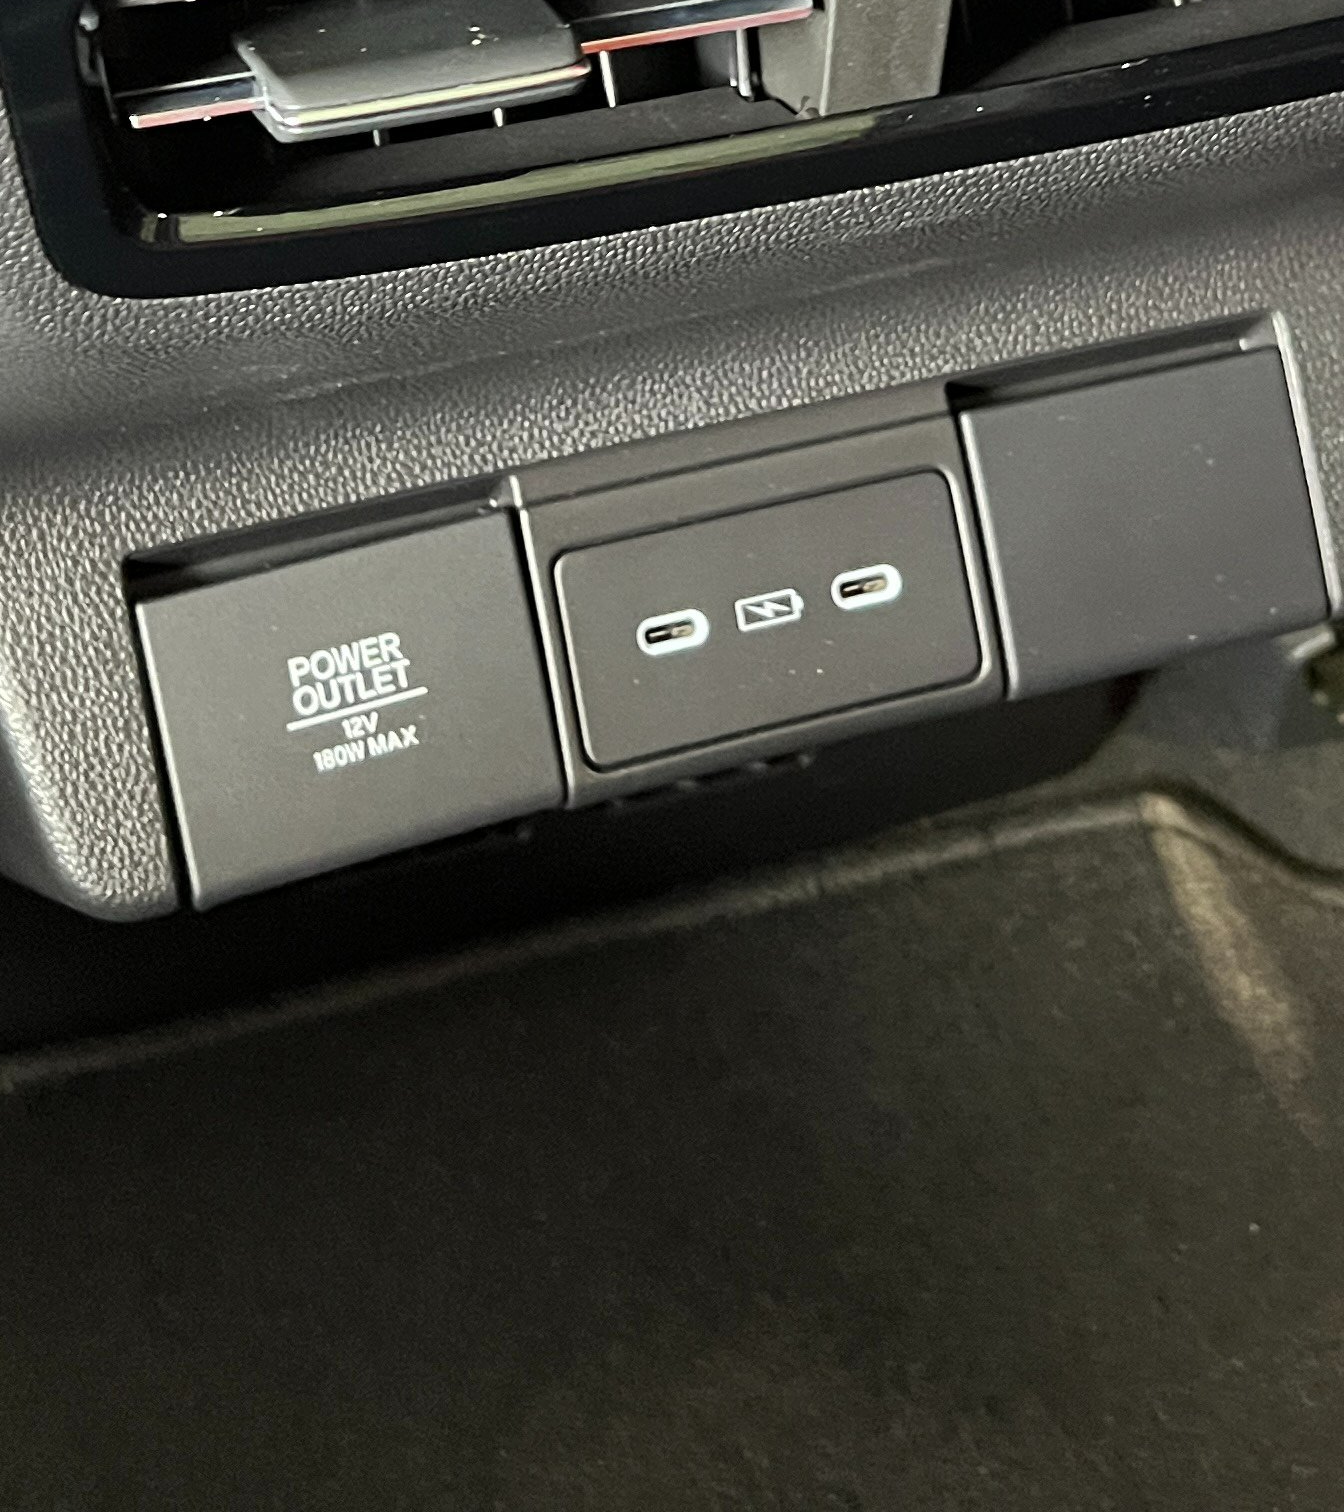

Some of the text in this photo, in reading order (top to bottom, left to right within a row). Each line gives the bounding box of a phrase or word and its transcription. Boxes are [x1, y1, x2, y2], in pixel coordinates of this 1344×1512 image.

[287, 631, 404, 687] POWER
[292, 658, 411, 716] OUTLET
[312, 724, 420, 772] 180W MAX
[342, 711, 379, 739] 12V
